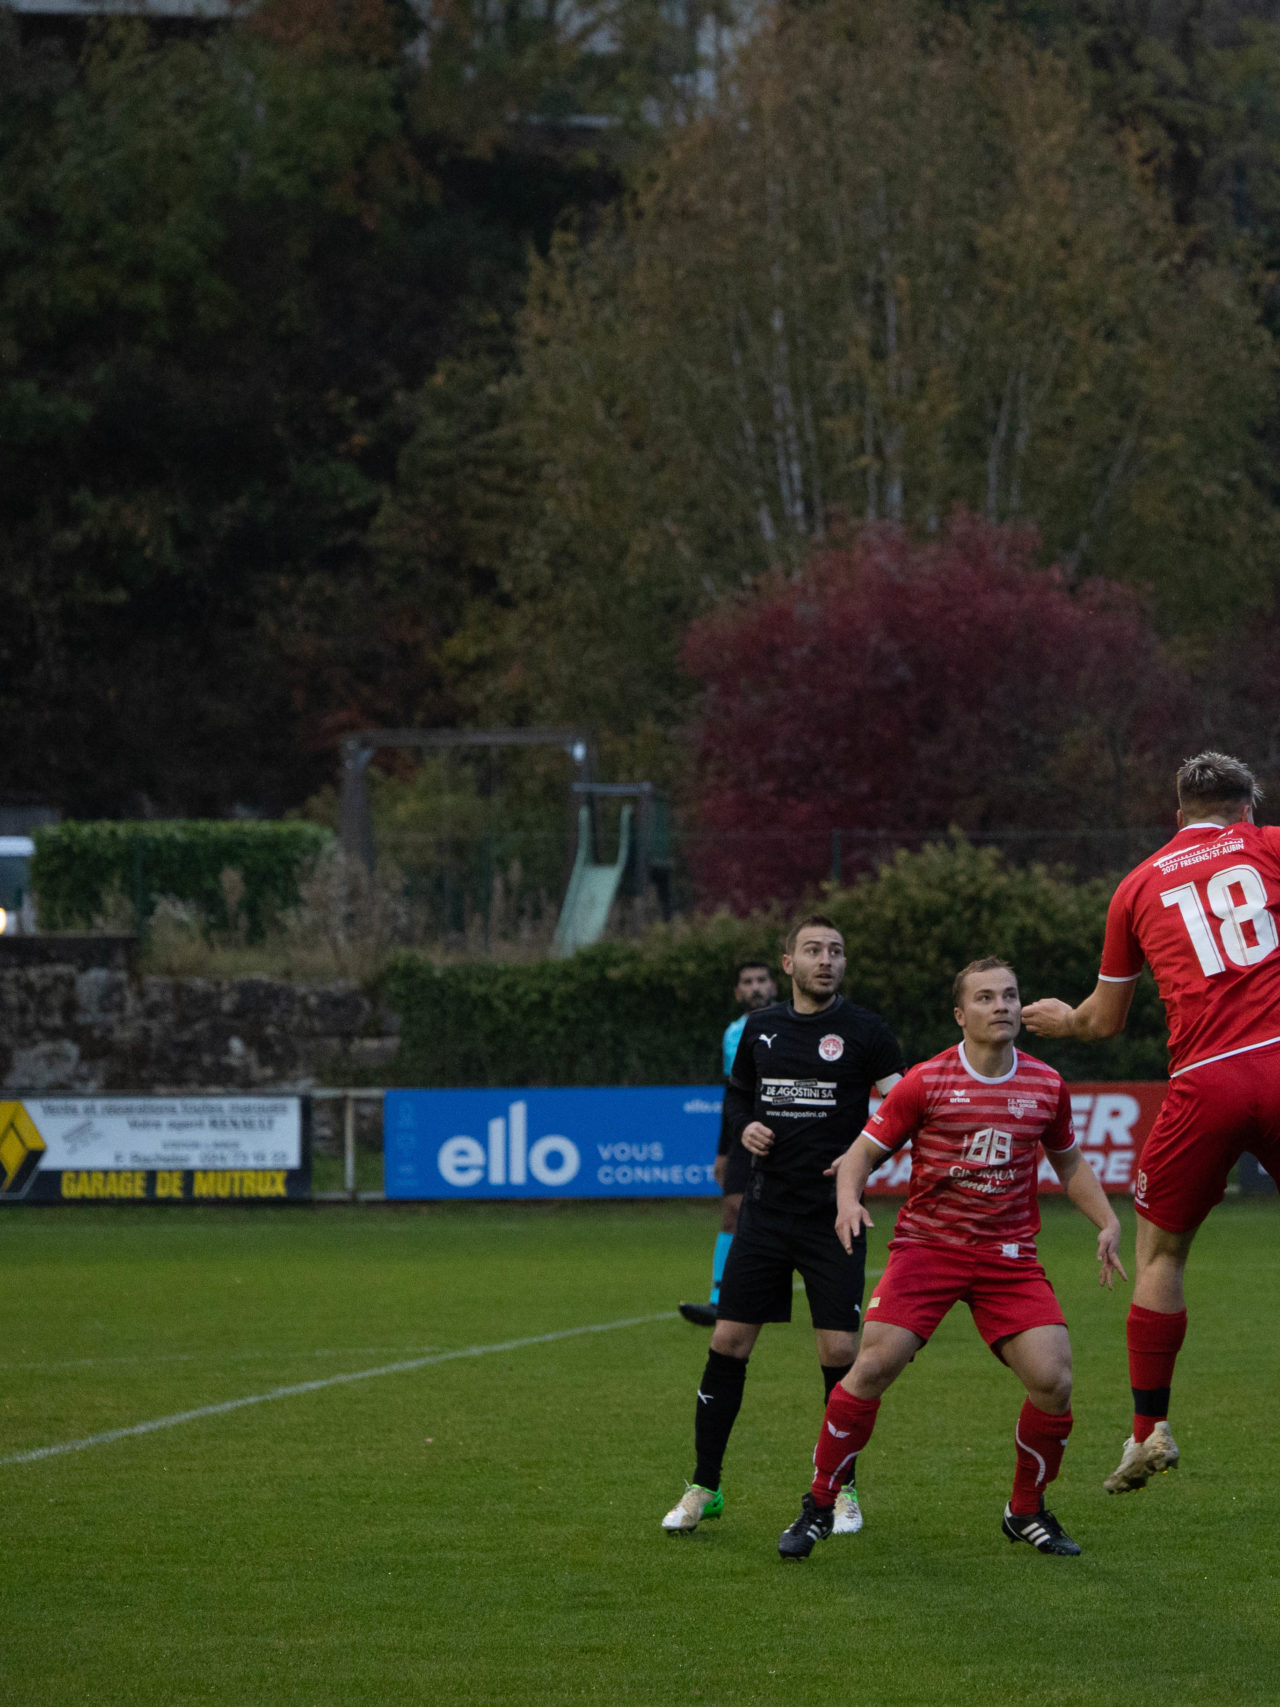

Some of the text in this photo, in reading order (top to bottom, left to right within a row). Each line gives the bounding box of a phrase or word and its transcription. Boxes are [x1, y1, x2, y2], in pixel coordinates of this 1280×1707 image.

[1161, 863, 1179, 875] 2027
[1160, 864, 1279, 977] 18
[766, 1086, 834, 1099] DE AGOSTINI SA
[766, 1110, 828, 1119] www.deagostini.ch
[437, 1099, 581, 1188] ello
[597, 1141, 665, 1163] VOUS
[61, 1170, 288, 1199] GARAGE DE MUTRUX
